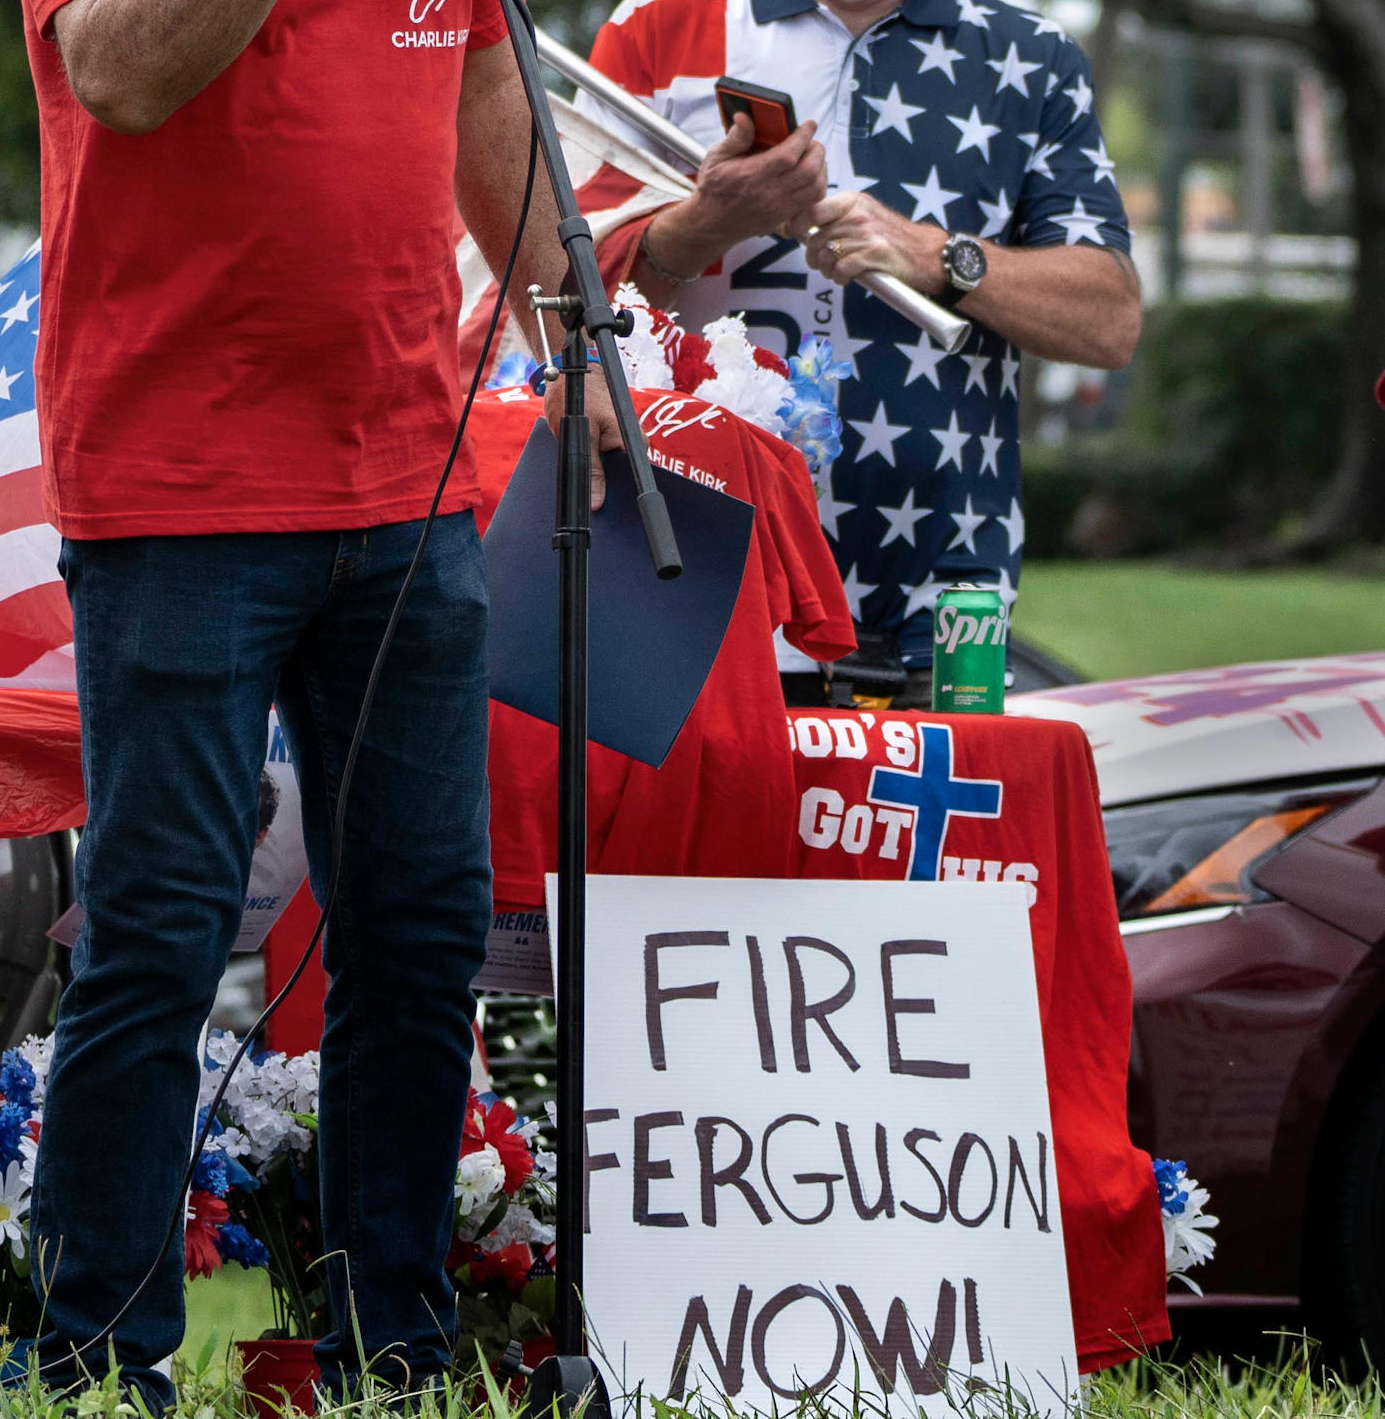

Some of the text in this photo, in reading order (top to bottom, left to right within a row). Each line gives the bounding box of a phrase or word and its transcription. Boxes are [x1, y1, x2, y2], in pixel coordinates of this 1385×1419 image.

[391, 31, 456, 49] CHARLIE
[689, 465, 728, 494] KIRK
[934, 605, 1006, 654] Spri
[798, 786, 913, 860] GOT
[644, 931, 970, 1079] FIRE
[582, 1109, 1053, 1234] FERGUSON
[669, 1278, 985, 1403] NOW!
